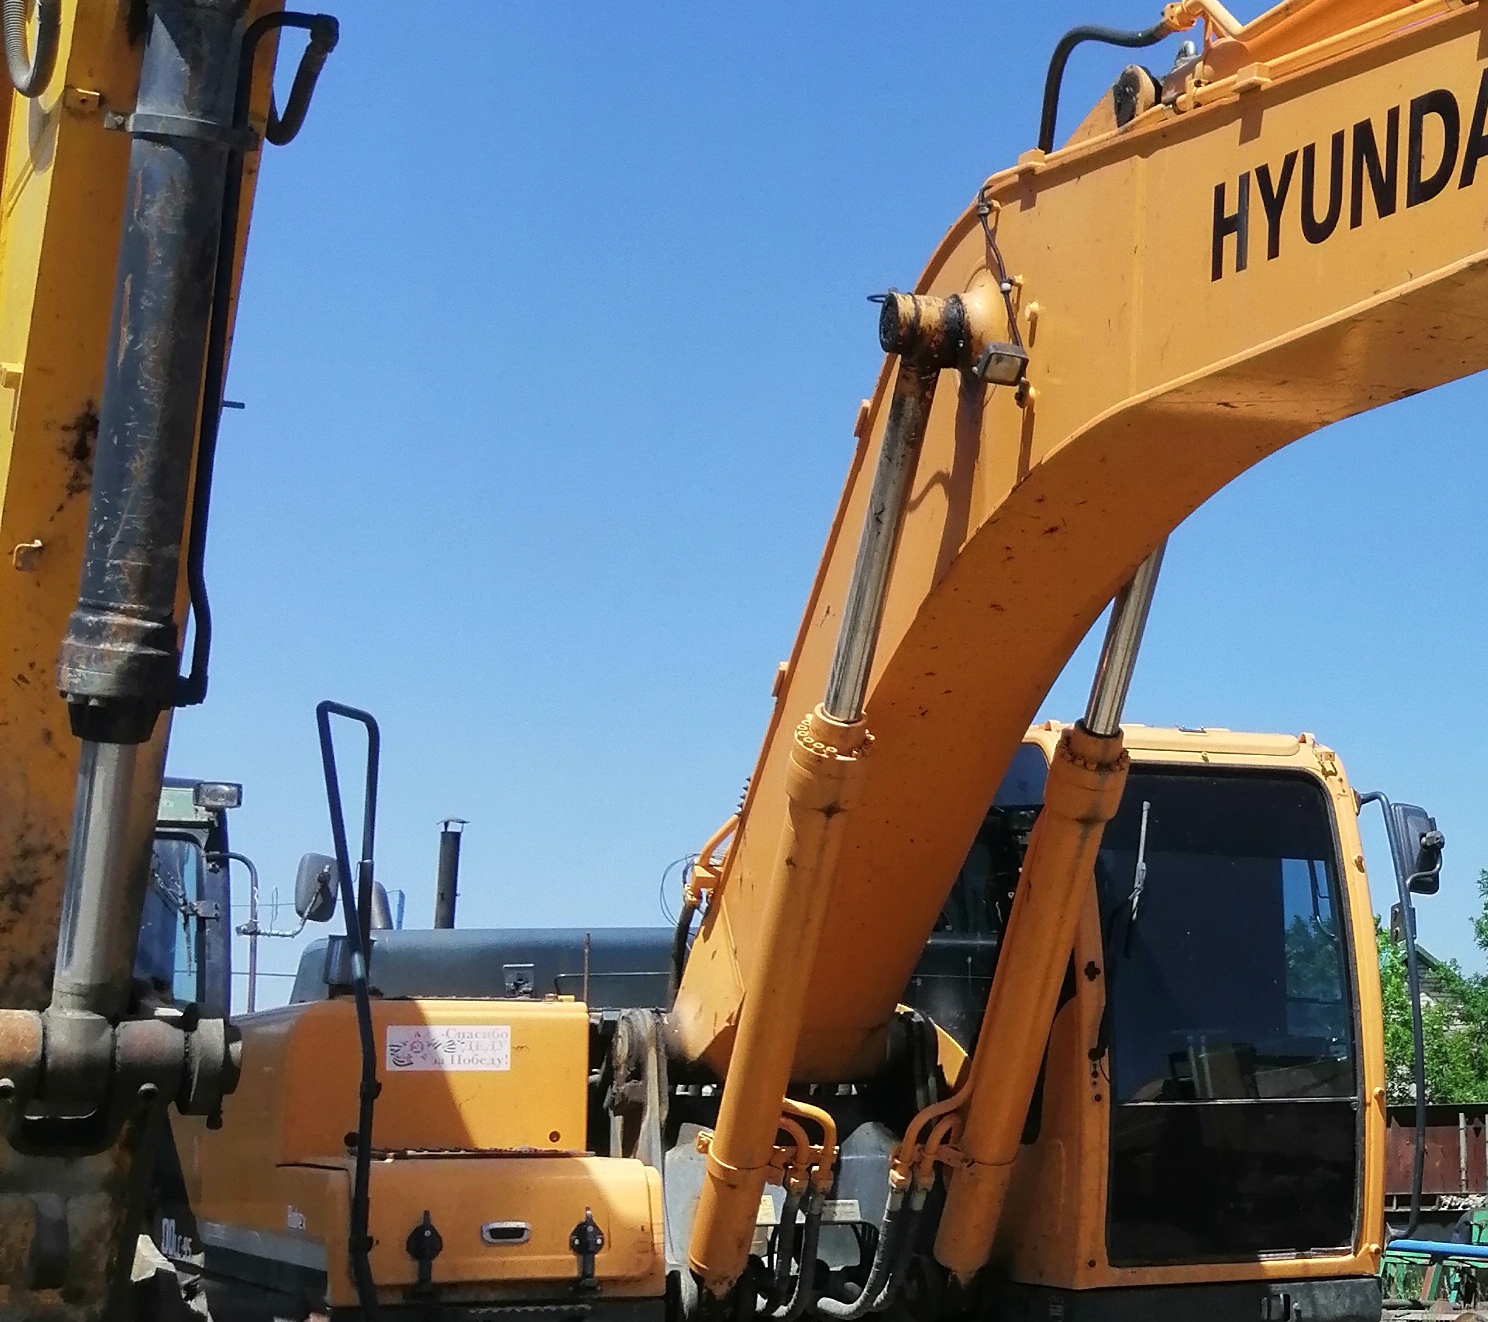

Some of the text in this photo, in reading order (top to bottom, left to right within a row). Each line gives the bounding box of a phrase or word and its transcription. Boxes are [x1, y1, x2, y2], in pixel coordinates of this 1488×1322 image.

[445, 1027, 509, 1039] Спасибо
[462, 1039, 506, 1052] ДЕДУ
[450, 1053, 509, 1068] Победу!
